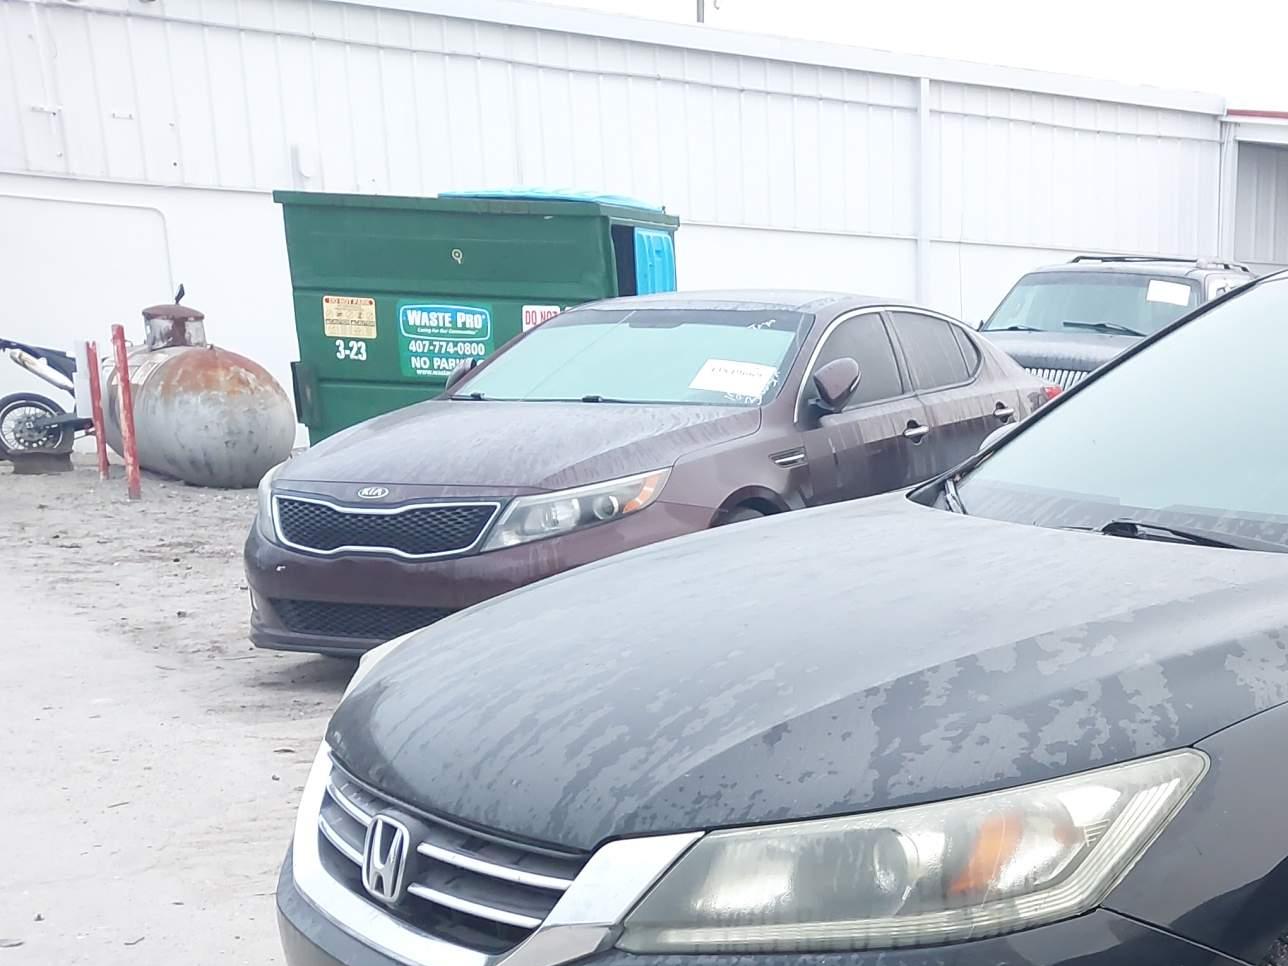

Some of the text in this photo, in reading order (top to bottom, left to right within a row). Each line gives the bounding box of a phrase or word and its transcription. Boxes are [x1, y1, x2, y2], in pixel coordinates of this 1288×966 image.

[407, 310, 483, 329] WASTE PRO
[525, 310, 558, 325] DO NO
[336, 340, 367, 361] 3-23
[408, 340, 485, 355] 407-774-0800
[411, 356, 430, 368] NO
[359, 486, 387, 497] KIA
